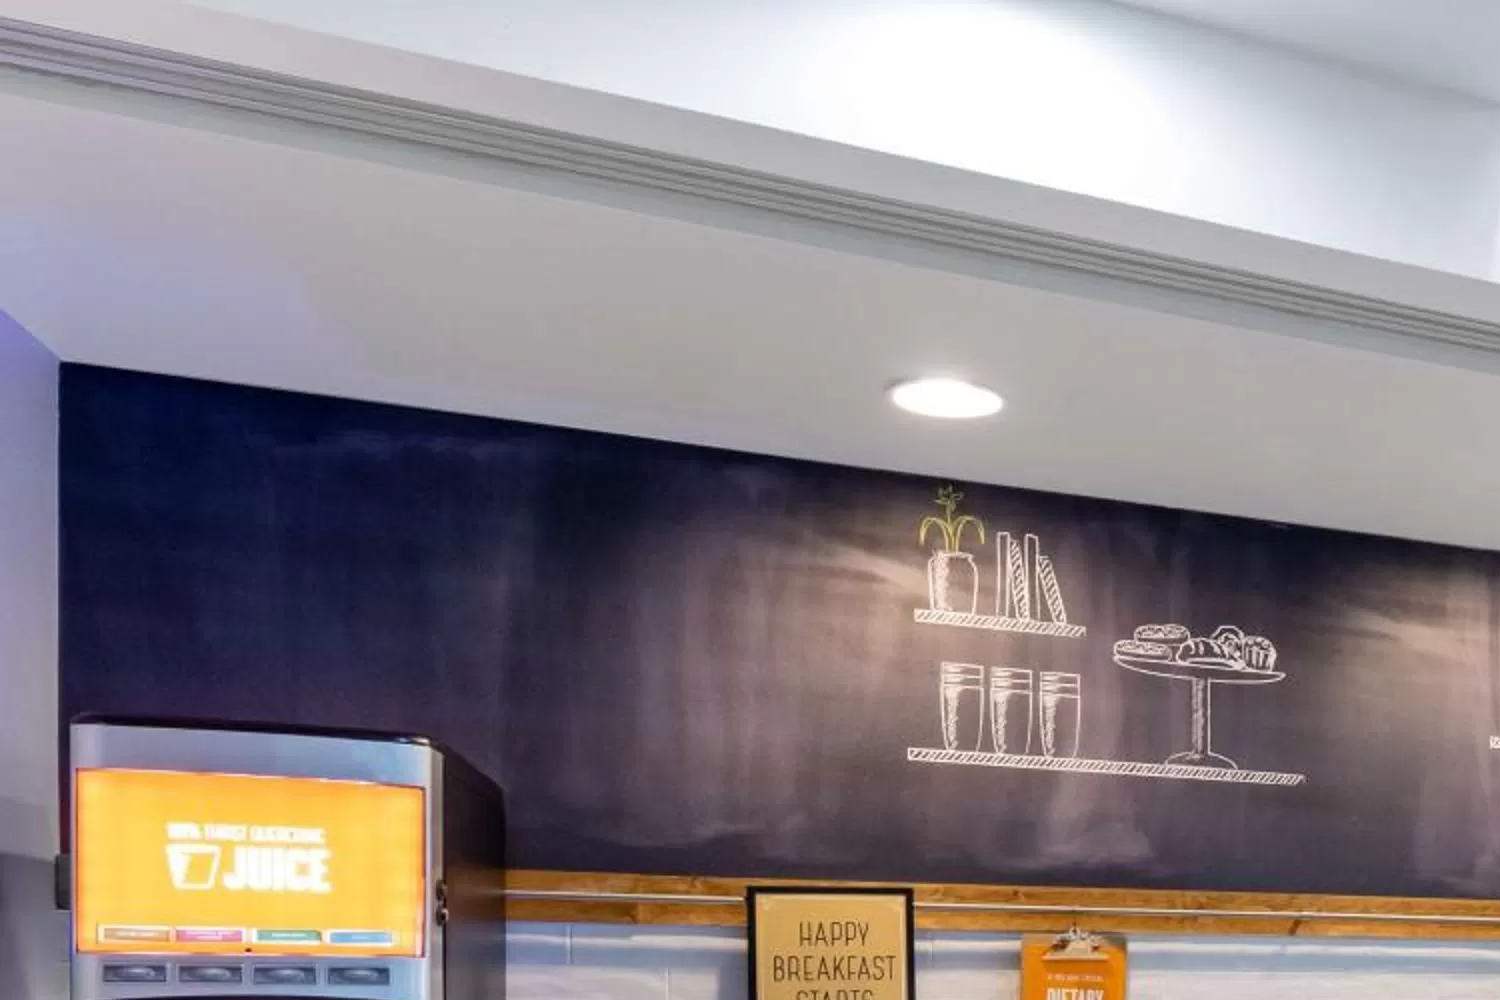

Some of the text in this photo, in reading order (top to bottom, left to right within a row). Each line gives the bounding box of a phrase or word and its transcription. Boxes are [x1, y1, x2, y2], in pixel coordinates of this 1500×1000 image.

[223, 845, 332, 893] JUICE
[799, 920, 869, 947] HAPPY
[772, 954, 897, 982] BREAKFAST
